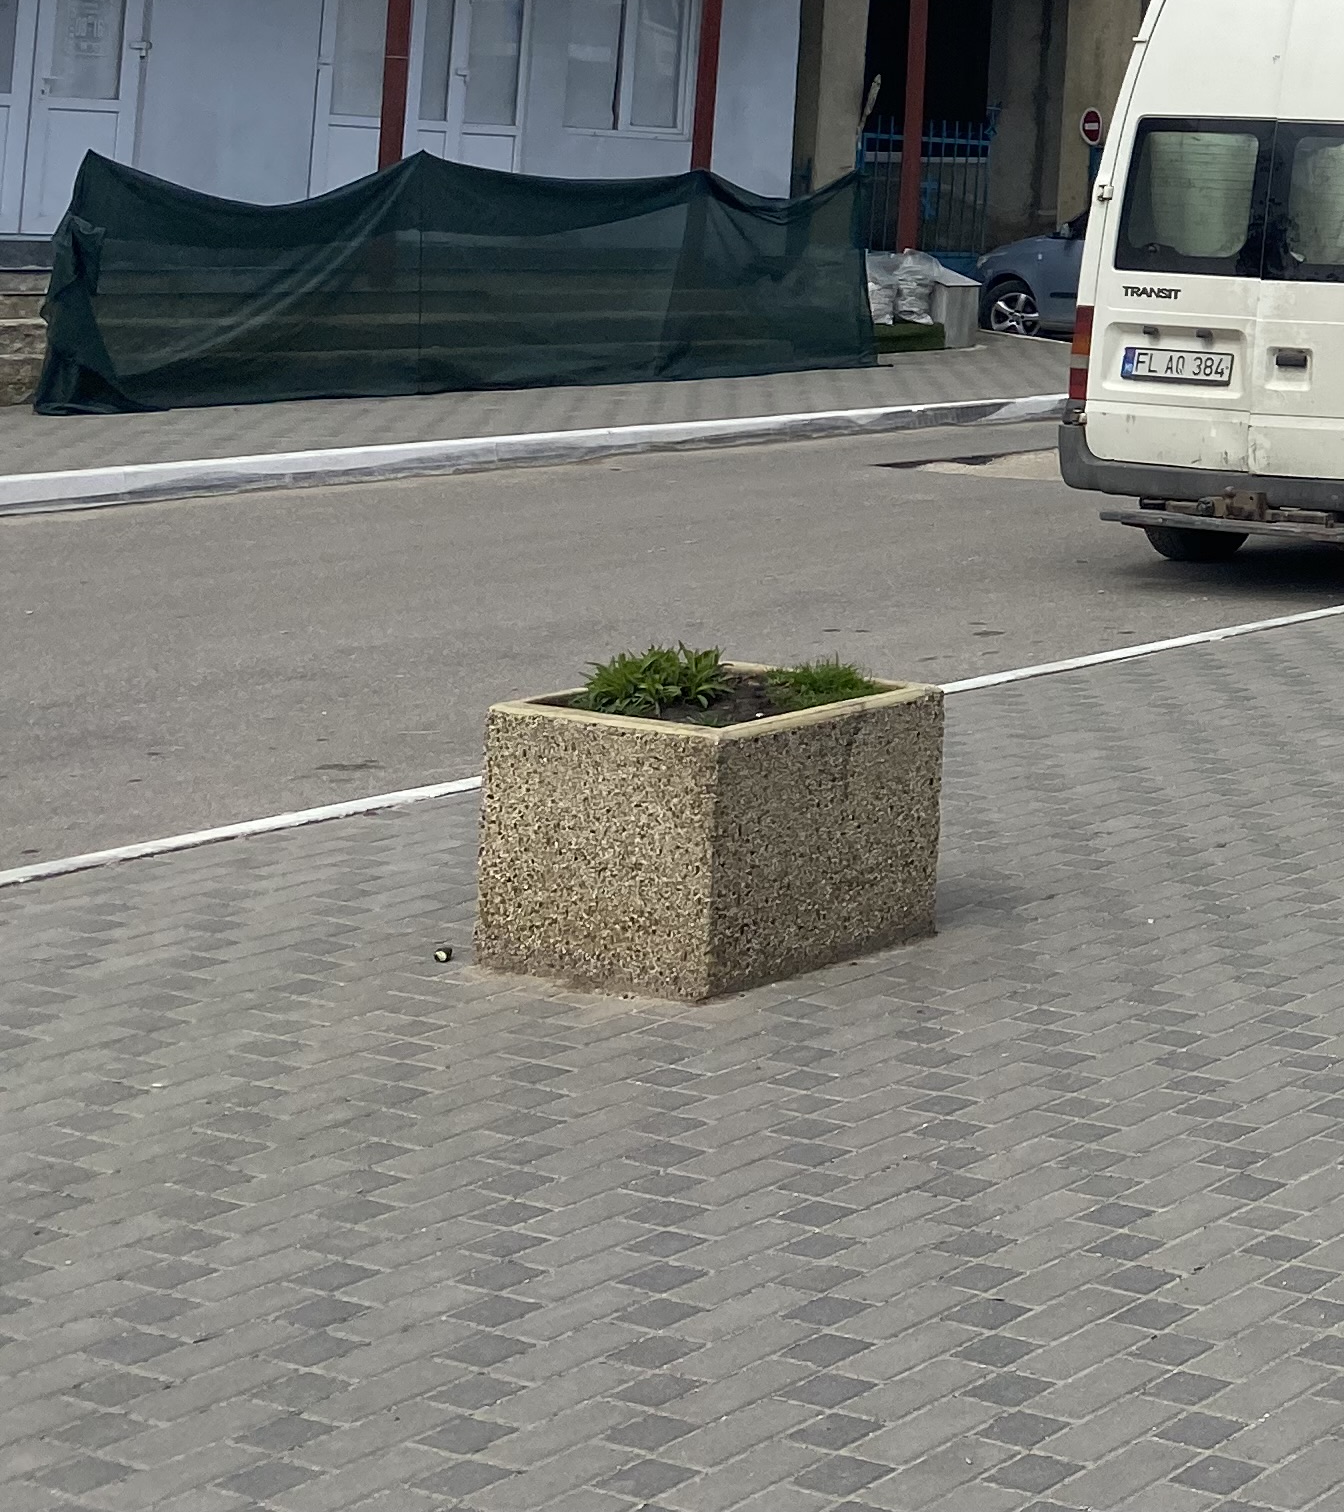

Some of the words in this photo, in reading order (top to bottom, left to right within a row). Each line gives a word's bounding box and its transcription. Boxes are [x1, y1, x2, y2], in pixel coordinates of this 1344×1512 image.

[1122, 285, 1181, 300] TRANSIT
[1135, 352, 1158, 373] FL
[1192, 356, 1225, 378] 384
